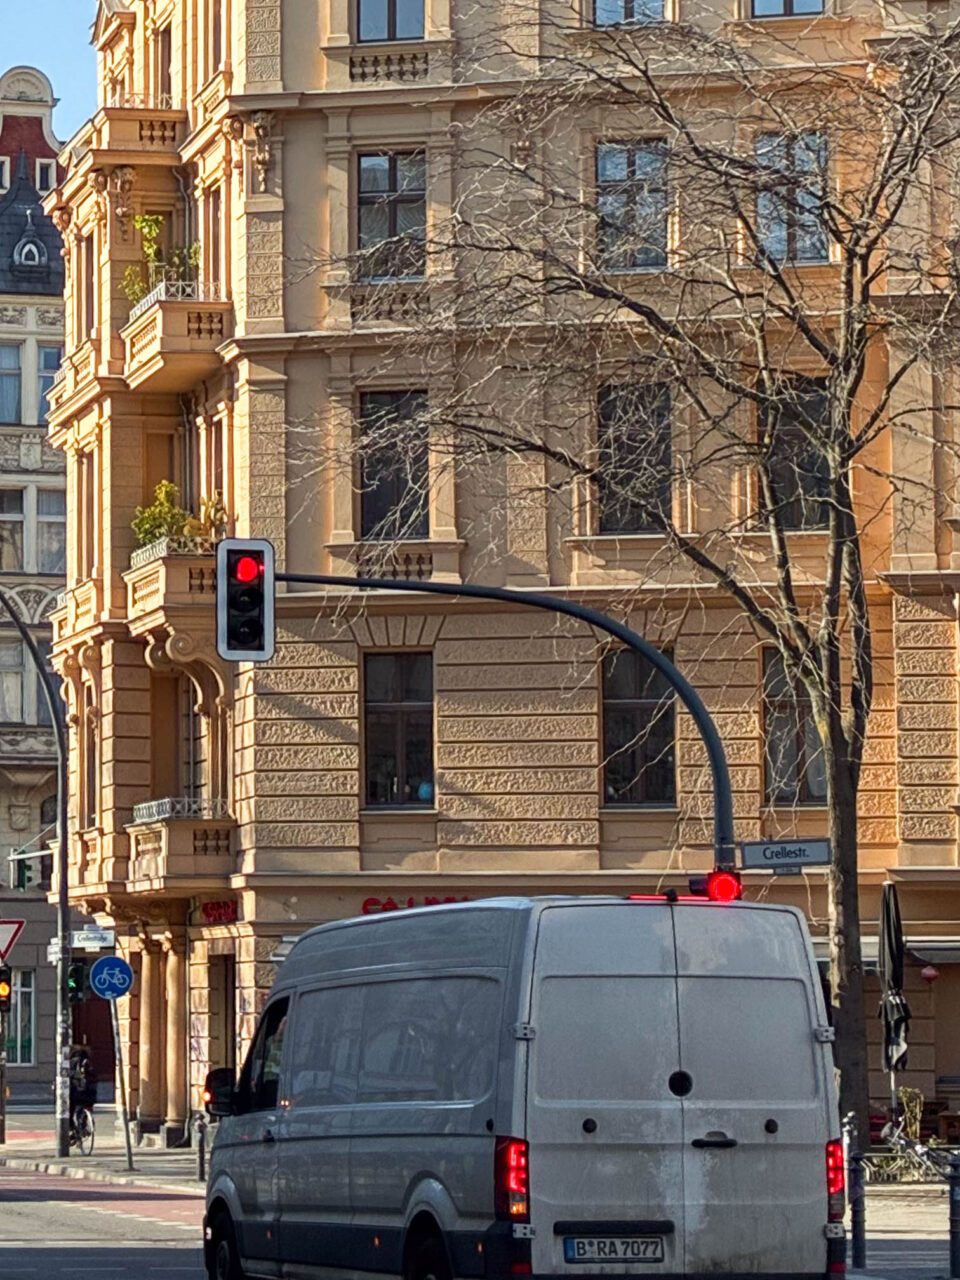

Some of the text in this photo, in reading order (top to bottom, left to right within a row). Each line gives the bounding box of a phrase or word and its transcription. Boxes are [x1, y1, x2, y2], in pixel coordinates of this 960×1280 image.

[762, 846, 810, 860] Crellestr.
[576, 1240, 659, 1256] B RA 7077
